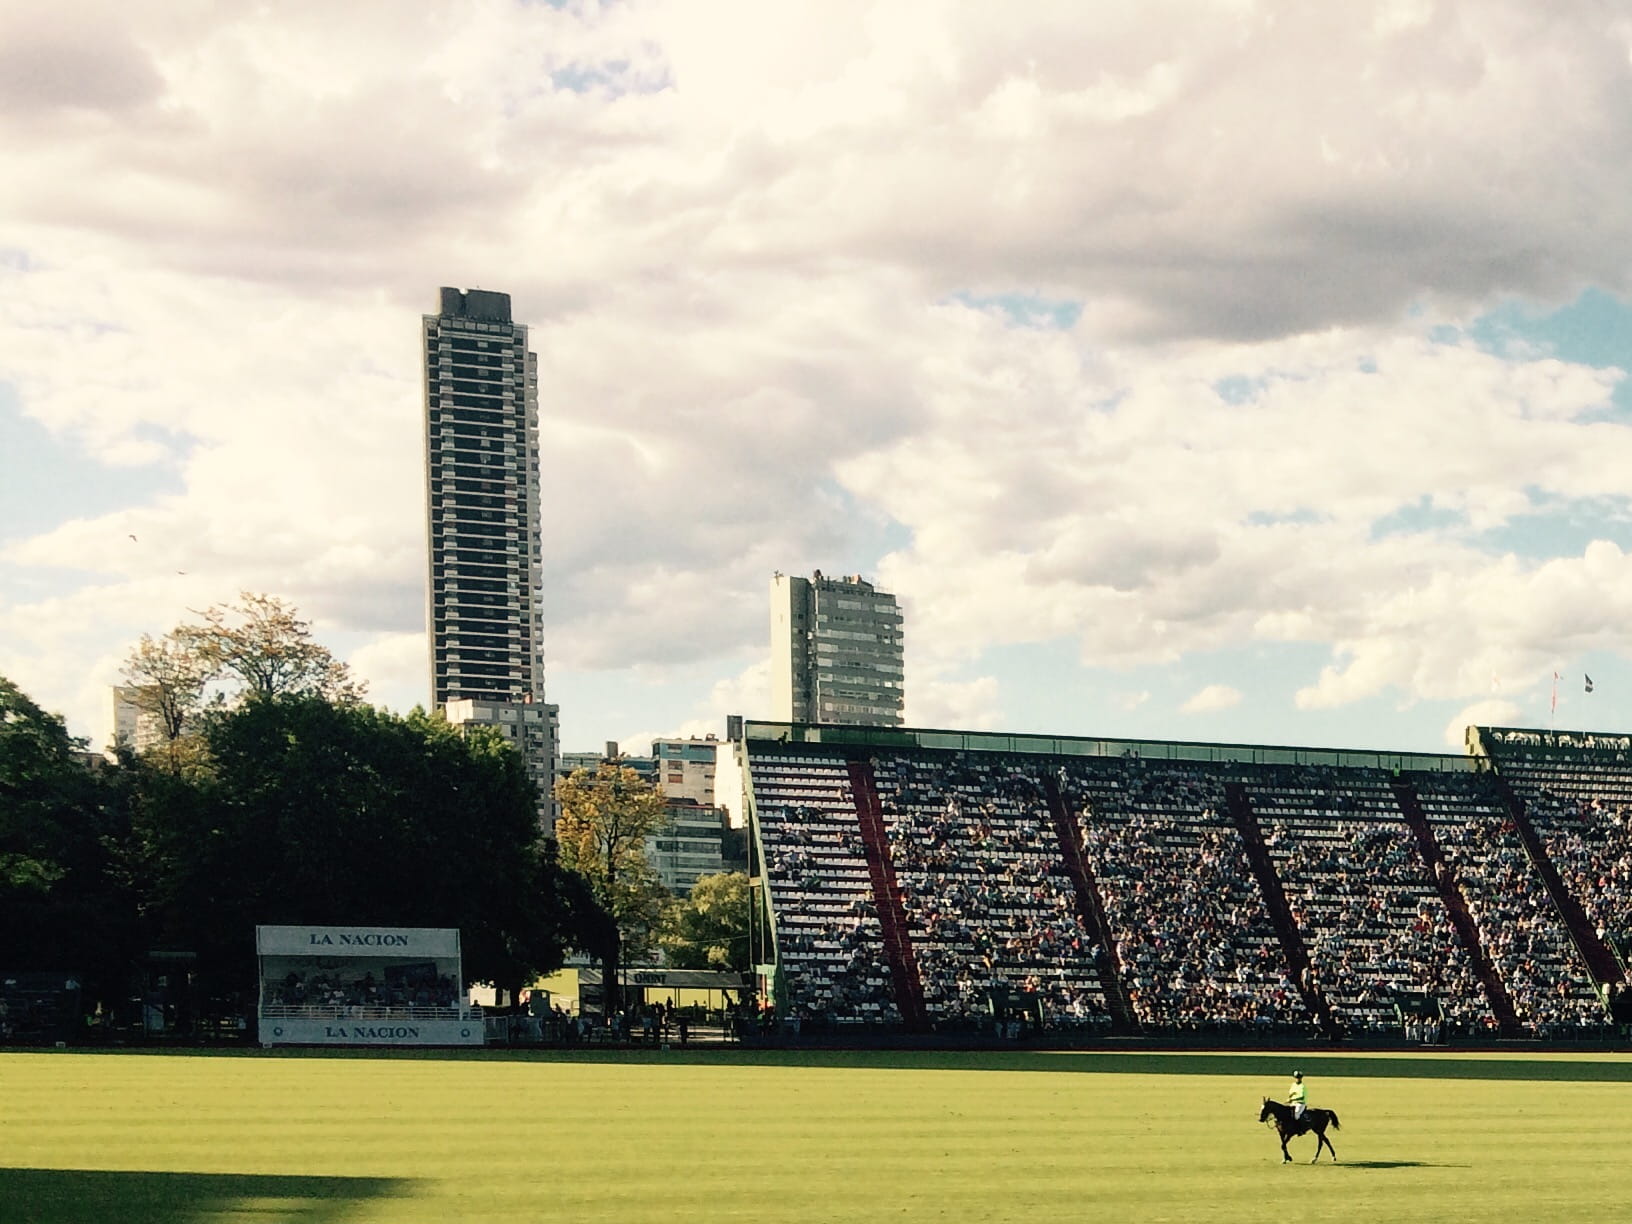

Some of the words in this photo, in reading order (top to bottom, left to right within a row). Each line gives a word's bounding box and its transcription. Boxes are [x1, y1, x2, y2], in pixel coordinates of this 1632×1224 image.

[310, 934, 333, 945] LA
[339, 934, 408, 946] NACION
[326, 1027, 348, 1038] LA
[354, 1027, 420, 1039] NACION
